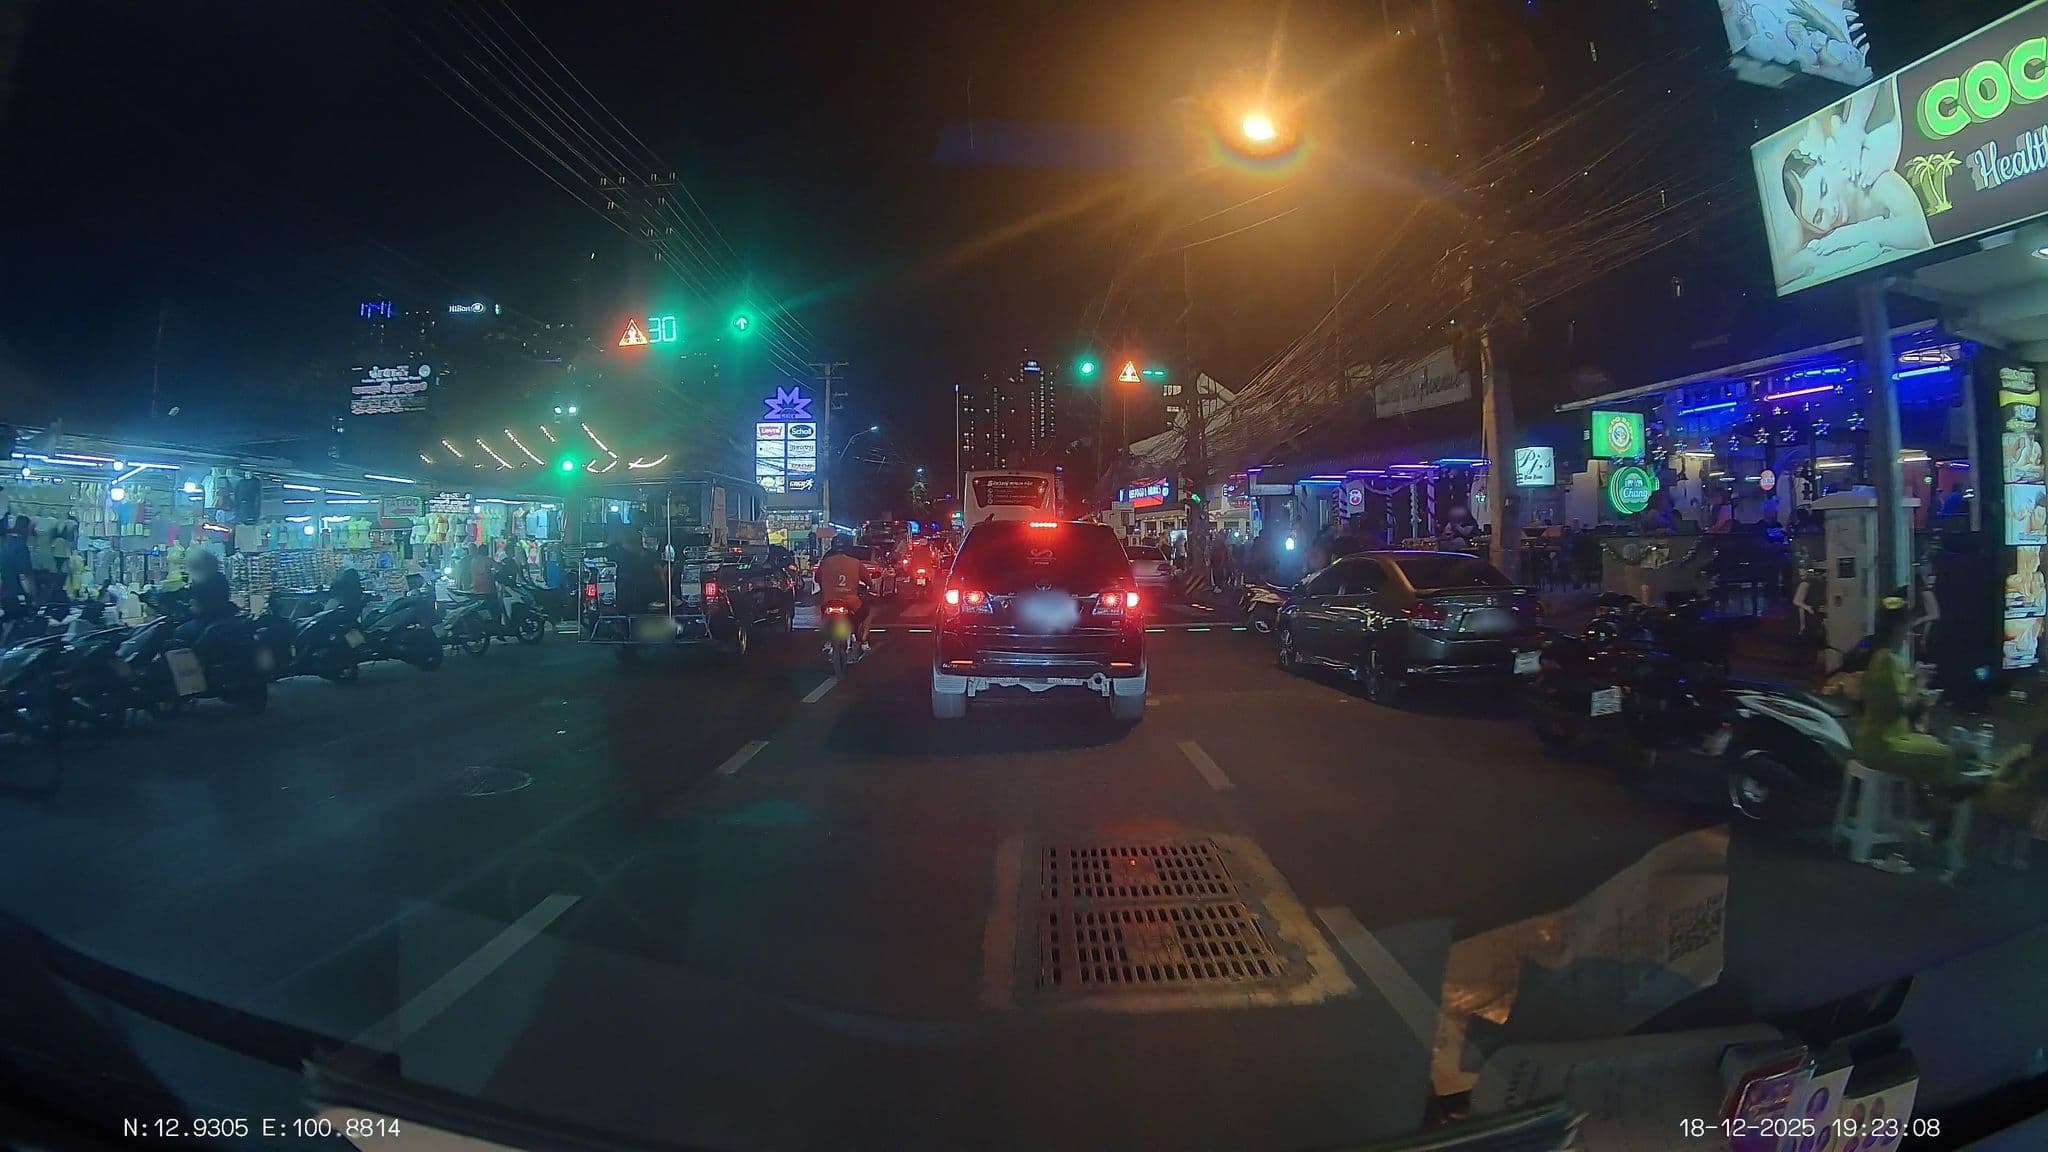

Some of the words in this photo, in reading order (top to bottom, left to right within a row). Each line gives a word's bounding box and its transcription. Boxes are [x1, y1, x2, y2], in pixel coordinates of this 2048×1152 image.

[648, 315, 677, 343] 30
[1622, 487, 1648, 500] Chang
[838, 575, 847, 587] 2
